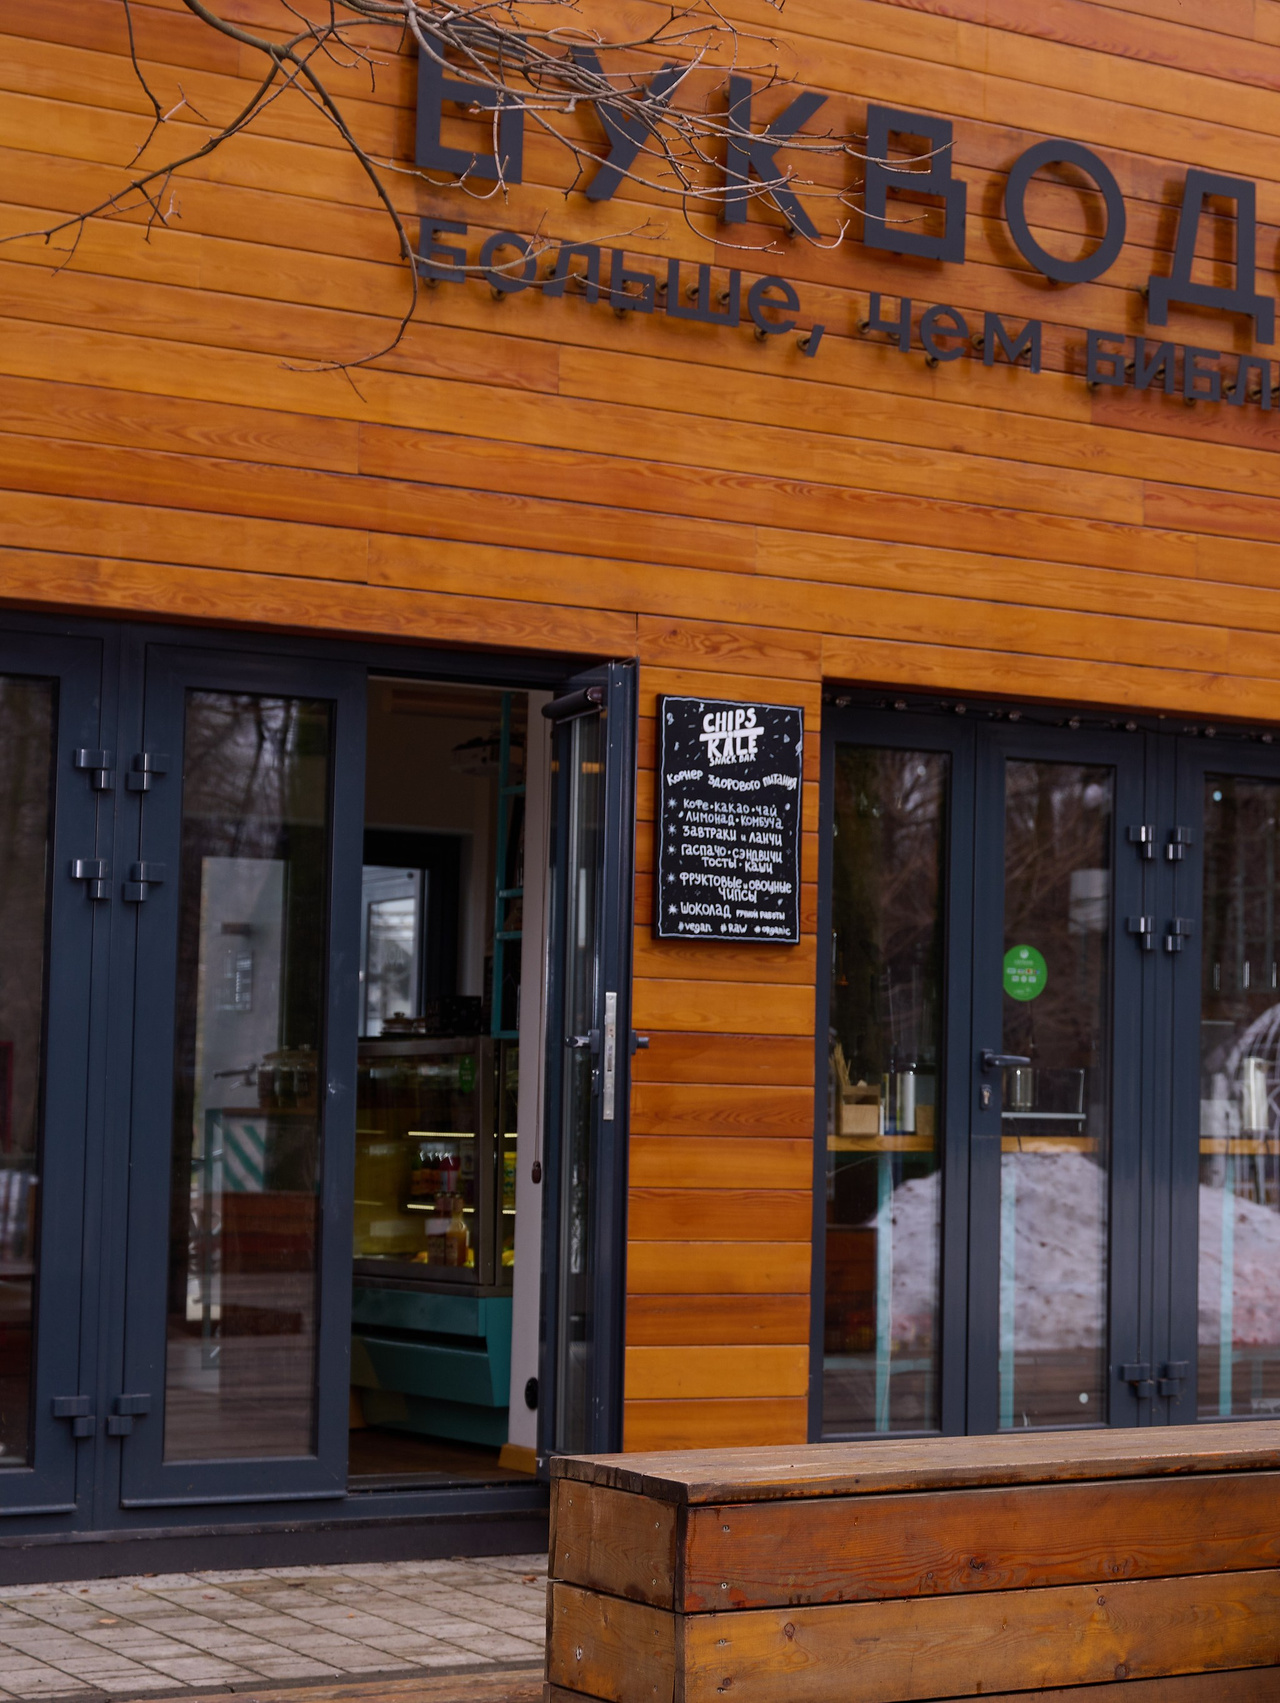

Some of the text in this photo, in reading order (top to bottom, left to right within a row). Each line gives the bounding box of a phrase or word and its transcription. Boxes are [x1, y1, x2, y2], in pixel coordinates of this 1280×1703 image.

[417, 216, 826, 358] Больше,
[868, 291, 1042, 374] чем
[703, 707, 757, 733] CHIPS
[707, 735, 759, 759] KALE
[709, 753, 757, 767] SNACK BAR
